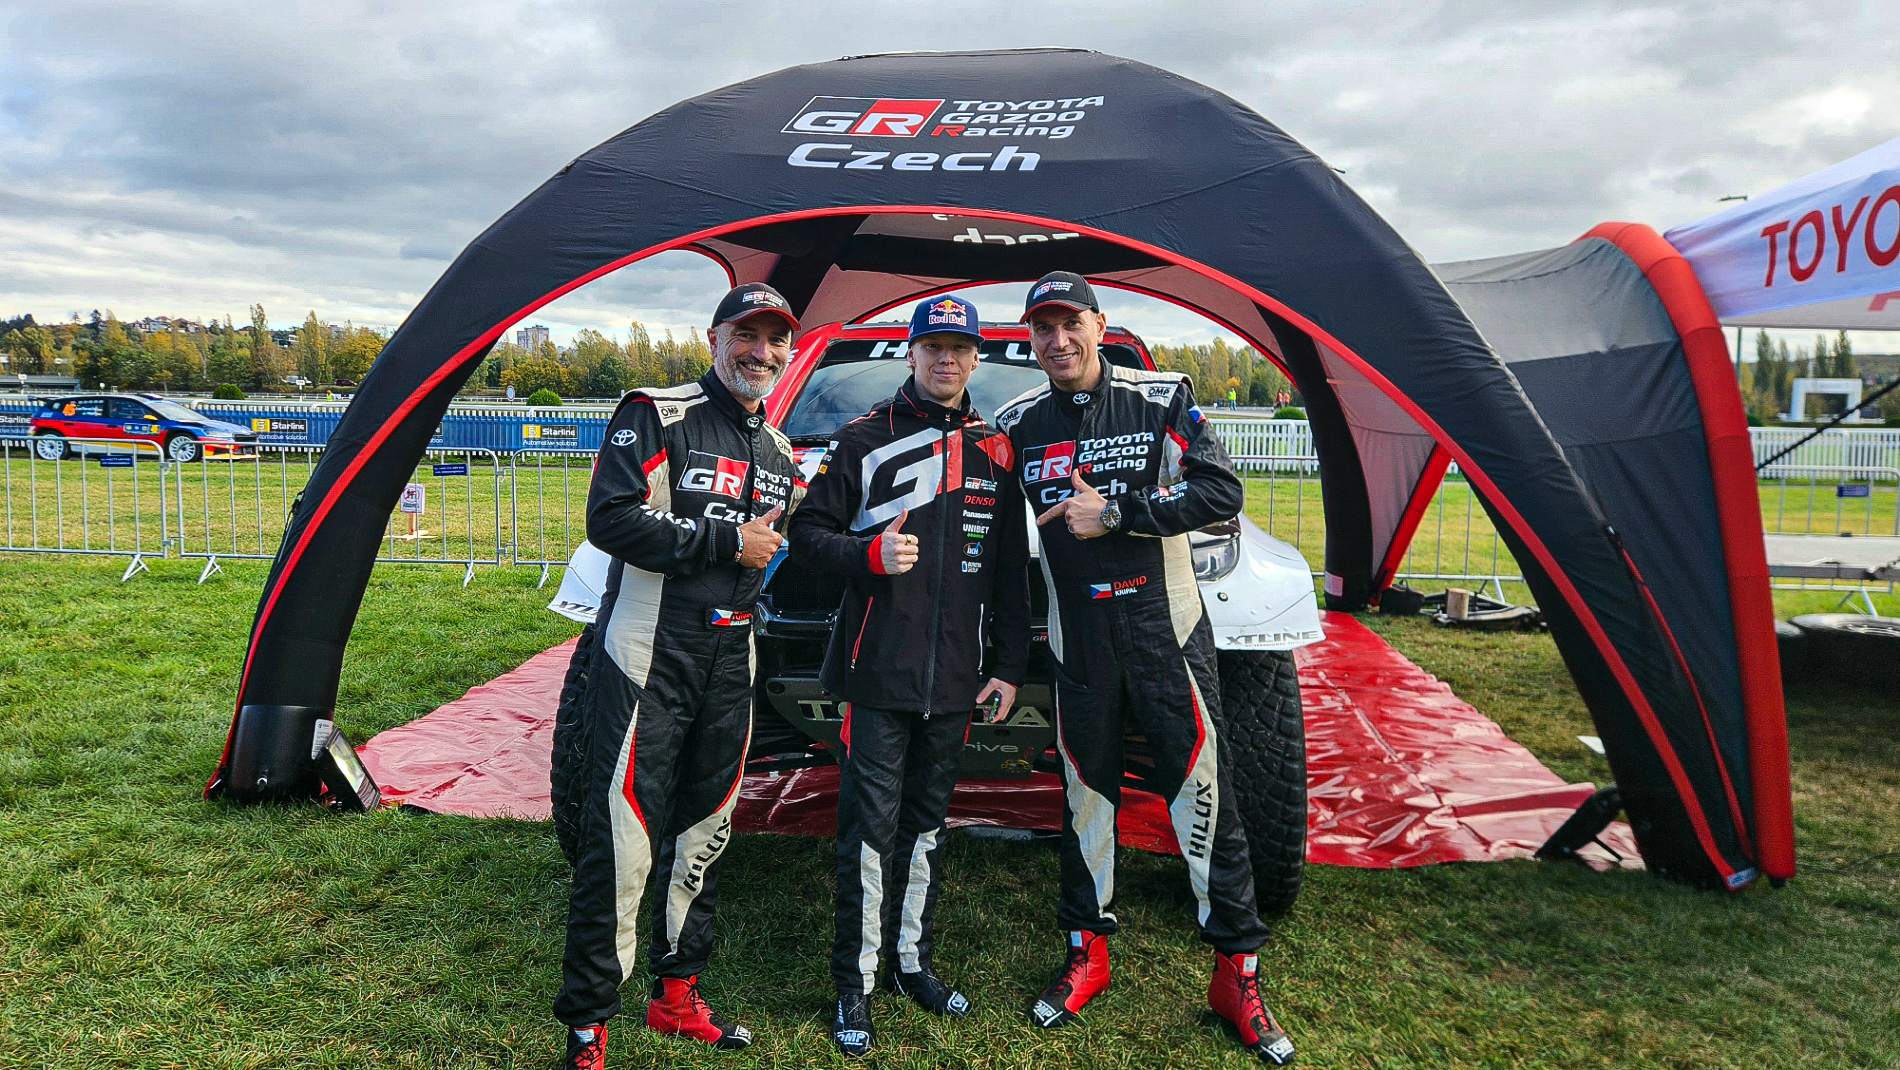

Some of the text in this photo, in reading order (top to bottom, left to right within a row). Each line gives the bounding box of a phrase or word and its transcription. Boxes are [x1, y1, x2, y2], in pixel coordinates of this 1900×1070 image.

[793, 95, 1105, 135] GR TOYOTA
[940, 110, 1086, 124] GAZOO
[931, 124, 1075, 139] Racing
[787, 142, 1041, 172] Czech
[929, 314, 966, 326] Red Bull
[1148, 387, 1170, 396] OMP
[271, 421, 305, 430] Starline
[1002, 411, 1019, 425] OMP
[542, 428, 576, 436] Starline
[1024, 432, 1155, 482] GR TOYOTA
[1078, 445, 1149, 463] GAZOO
[1079, 457, 1147, 475] Racing
[681, 468, 741, 497] GR
[1041, 478, 1128, 505] Czch
[752, 489, 786, 511] Racing
[964, 495, 996, 507] DENSO
[963, 510, 993, 519] Panasonic
[963, 524, 989, 534] UNIBET
[1113, 575, 1147, 590] DAVID
[1225, 630, 1318, 646] XTLINE
[1189, 778, 1213, 860] HILUX
